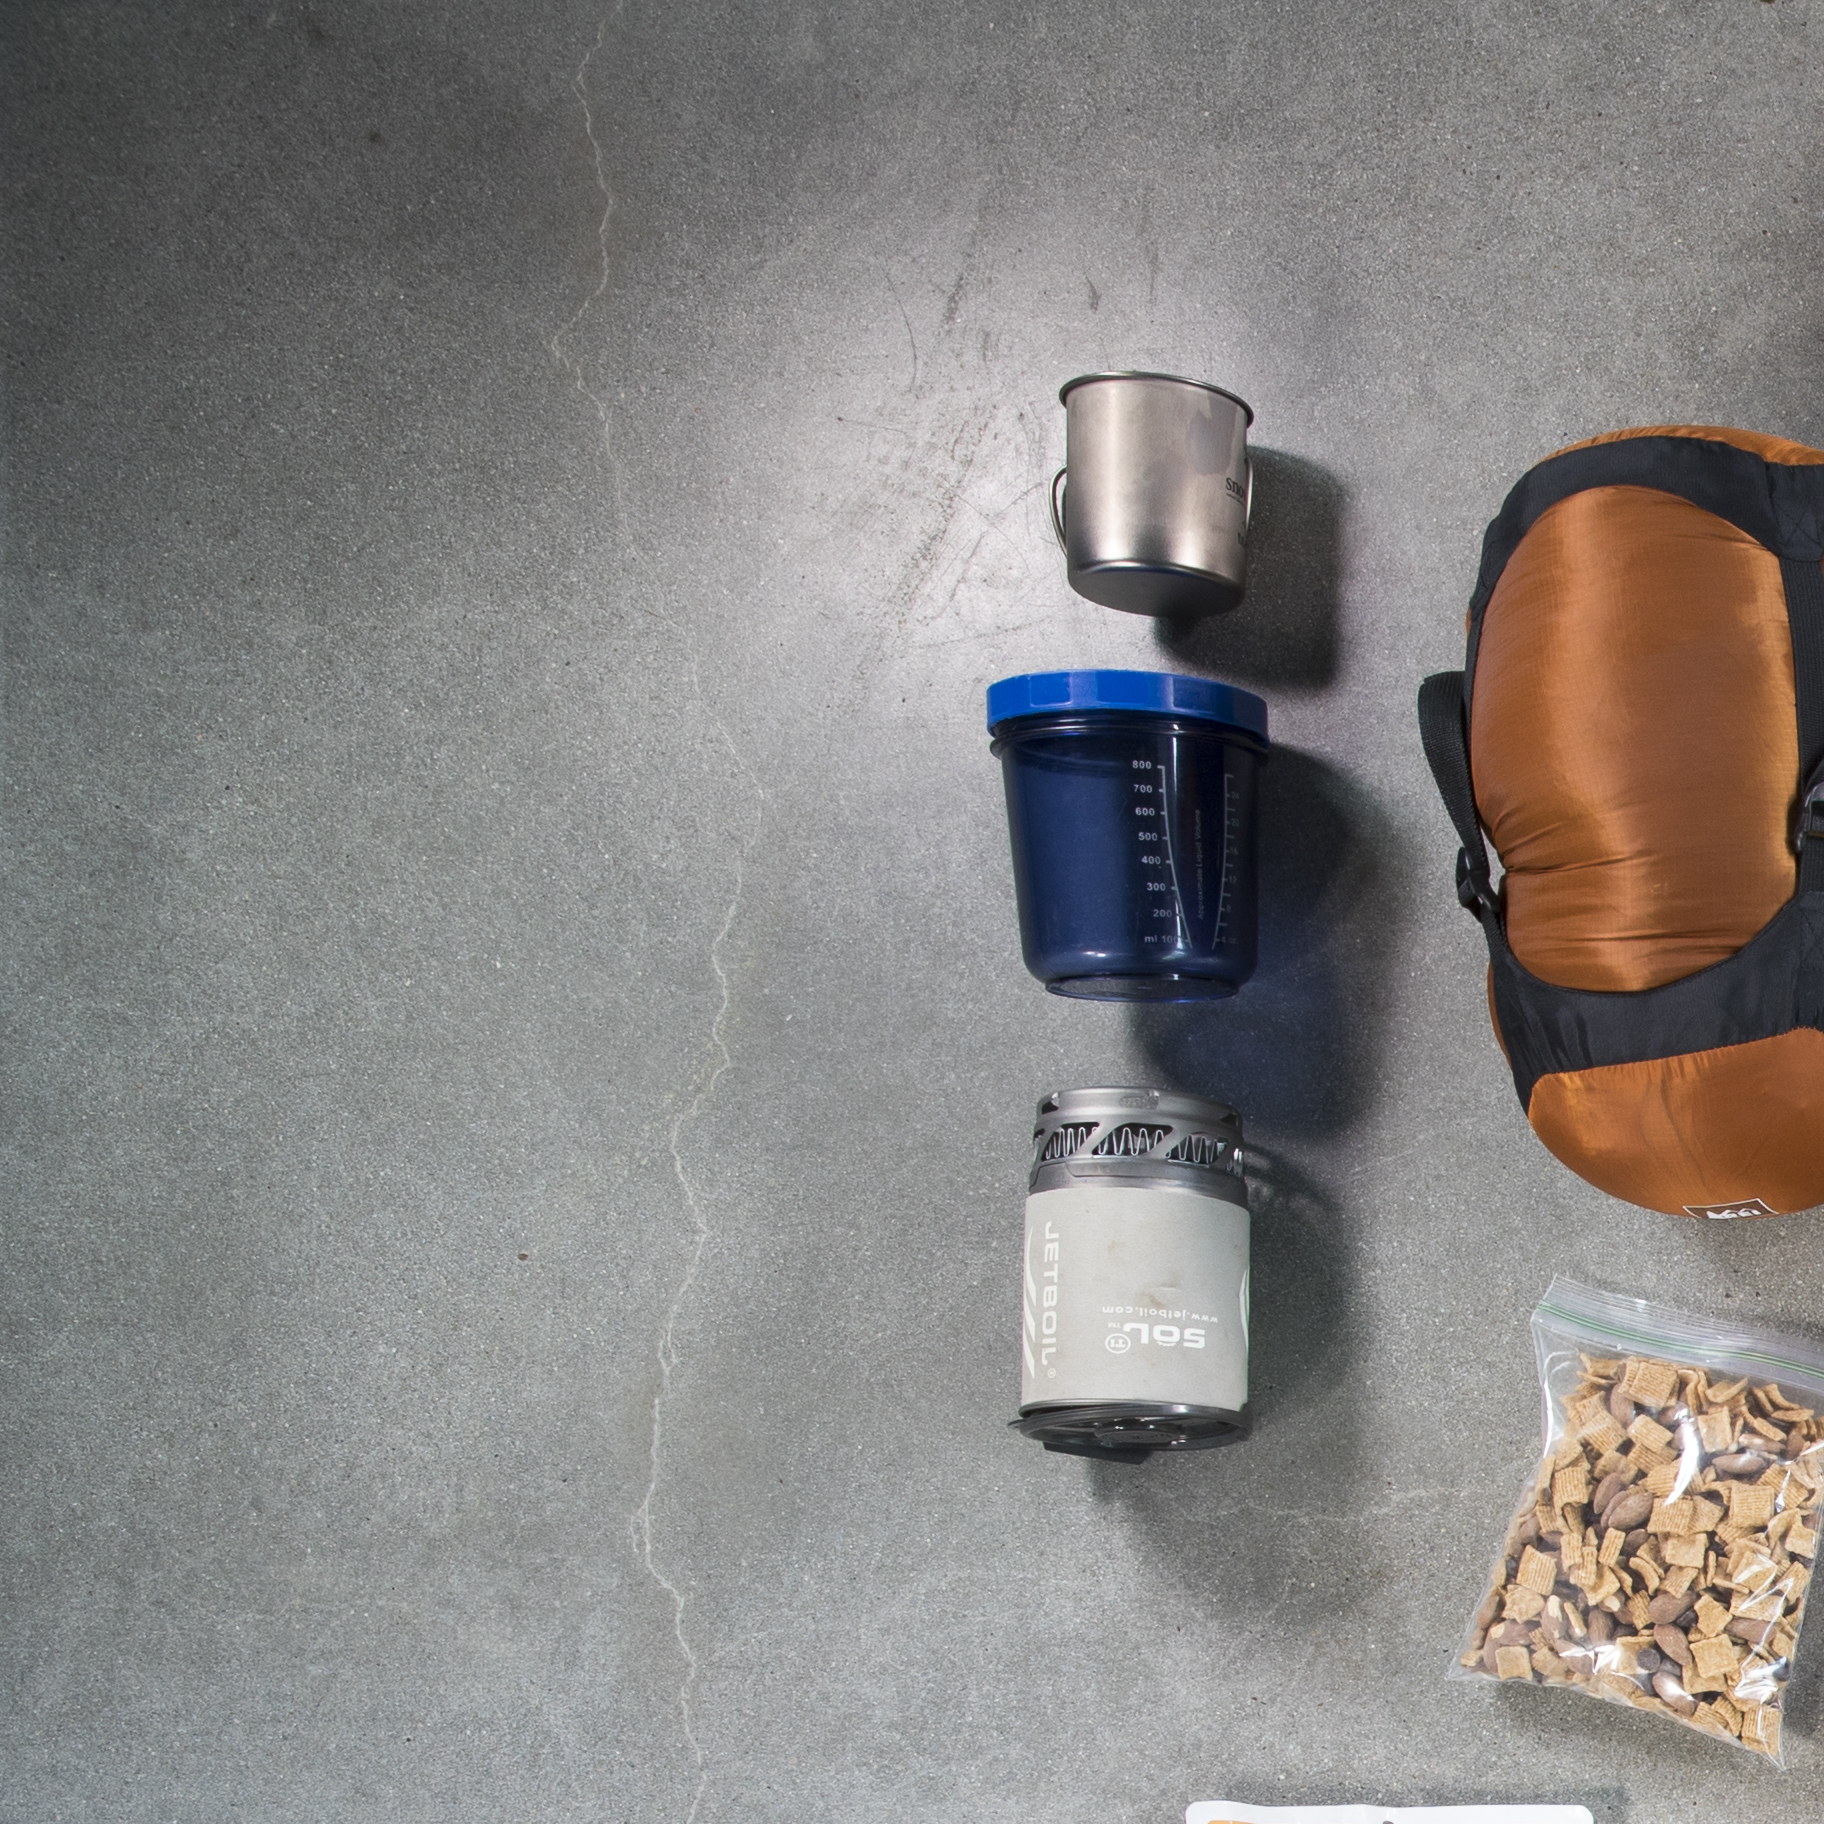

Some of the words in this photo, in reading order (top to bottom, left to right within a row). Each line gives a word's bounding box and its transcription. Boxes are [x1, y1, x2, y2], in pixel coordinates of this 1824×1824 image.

[1132, 760, 1152, 770] 800
[1133, 784, 1153, 794] 700
[1135, 807, 1155, 816] 600
[1138, 832, 1158, 841] 500
[1141, 855, 1161, 865] 400
[1146, 882, 1166, 891] 300
[1153, 909, 1172, 918] 200
[1041, 1220, 1060, 1366] JETBOIL
[1102, 1305, 1219, 1324] www.jetboil.com
